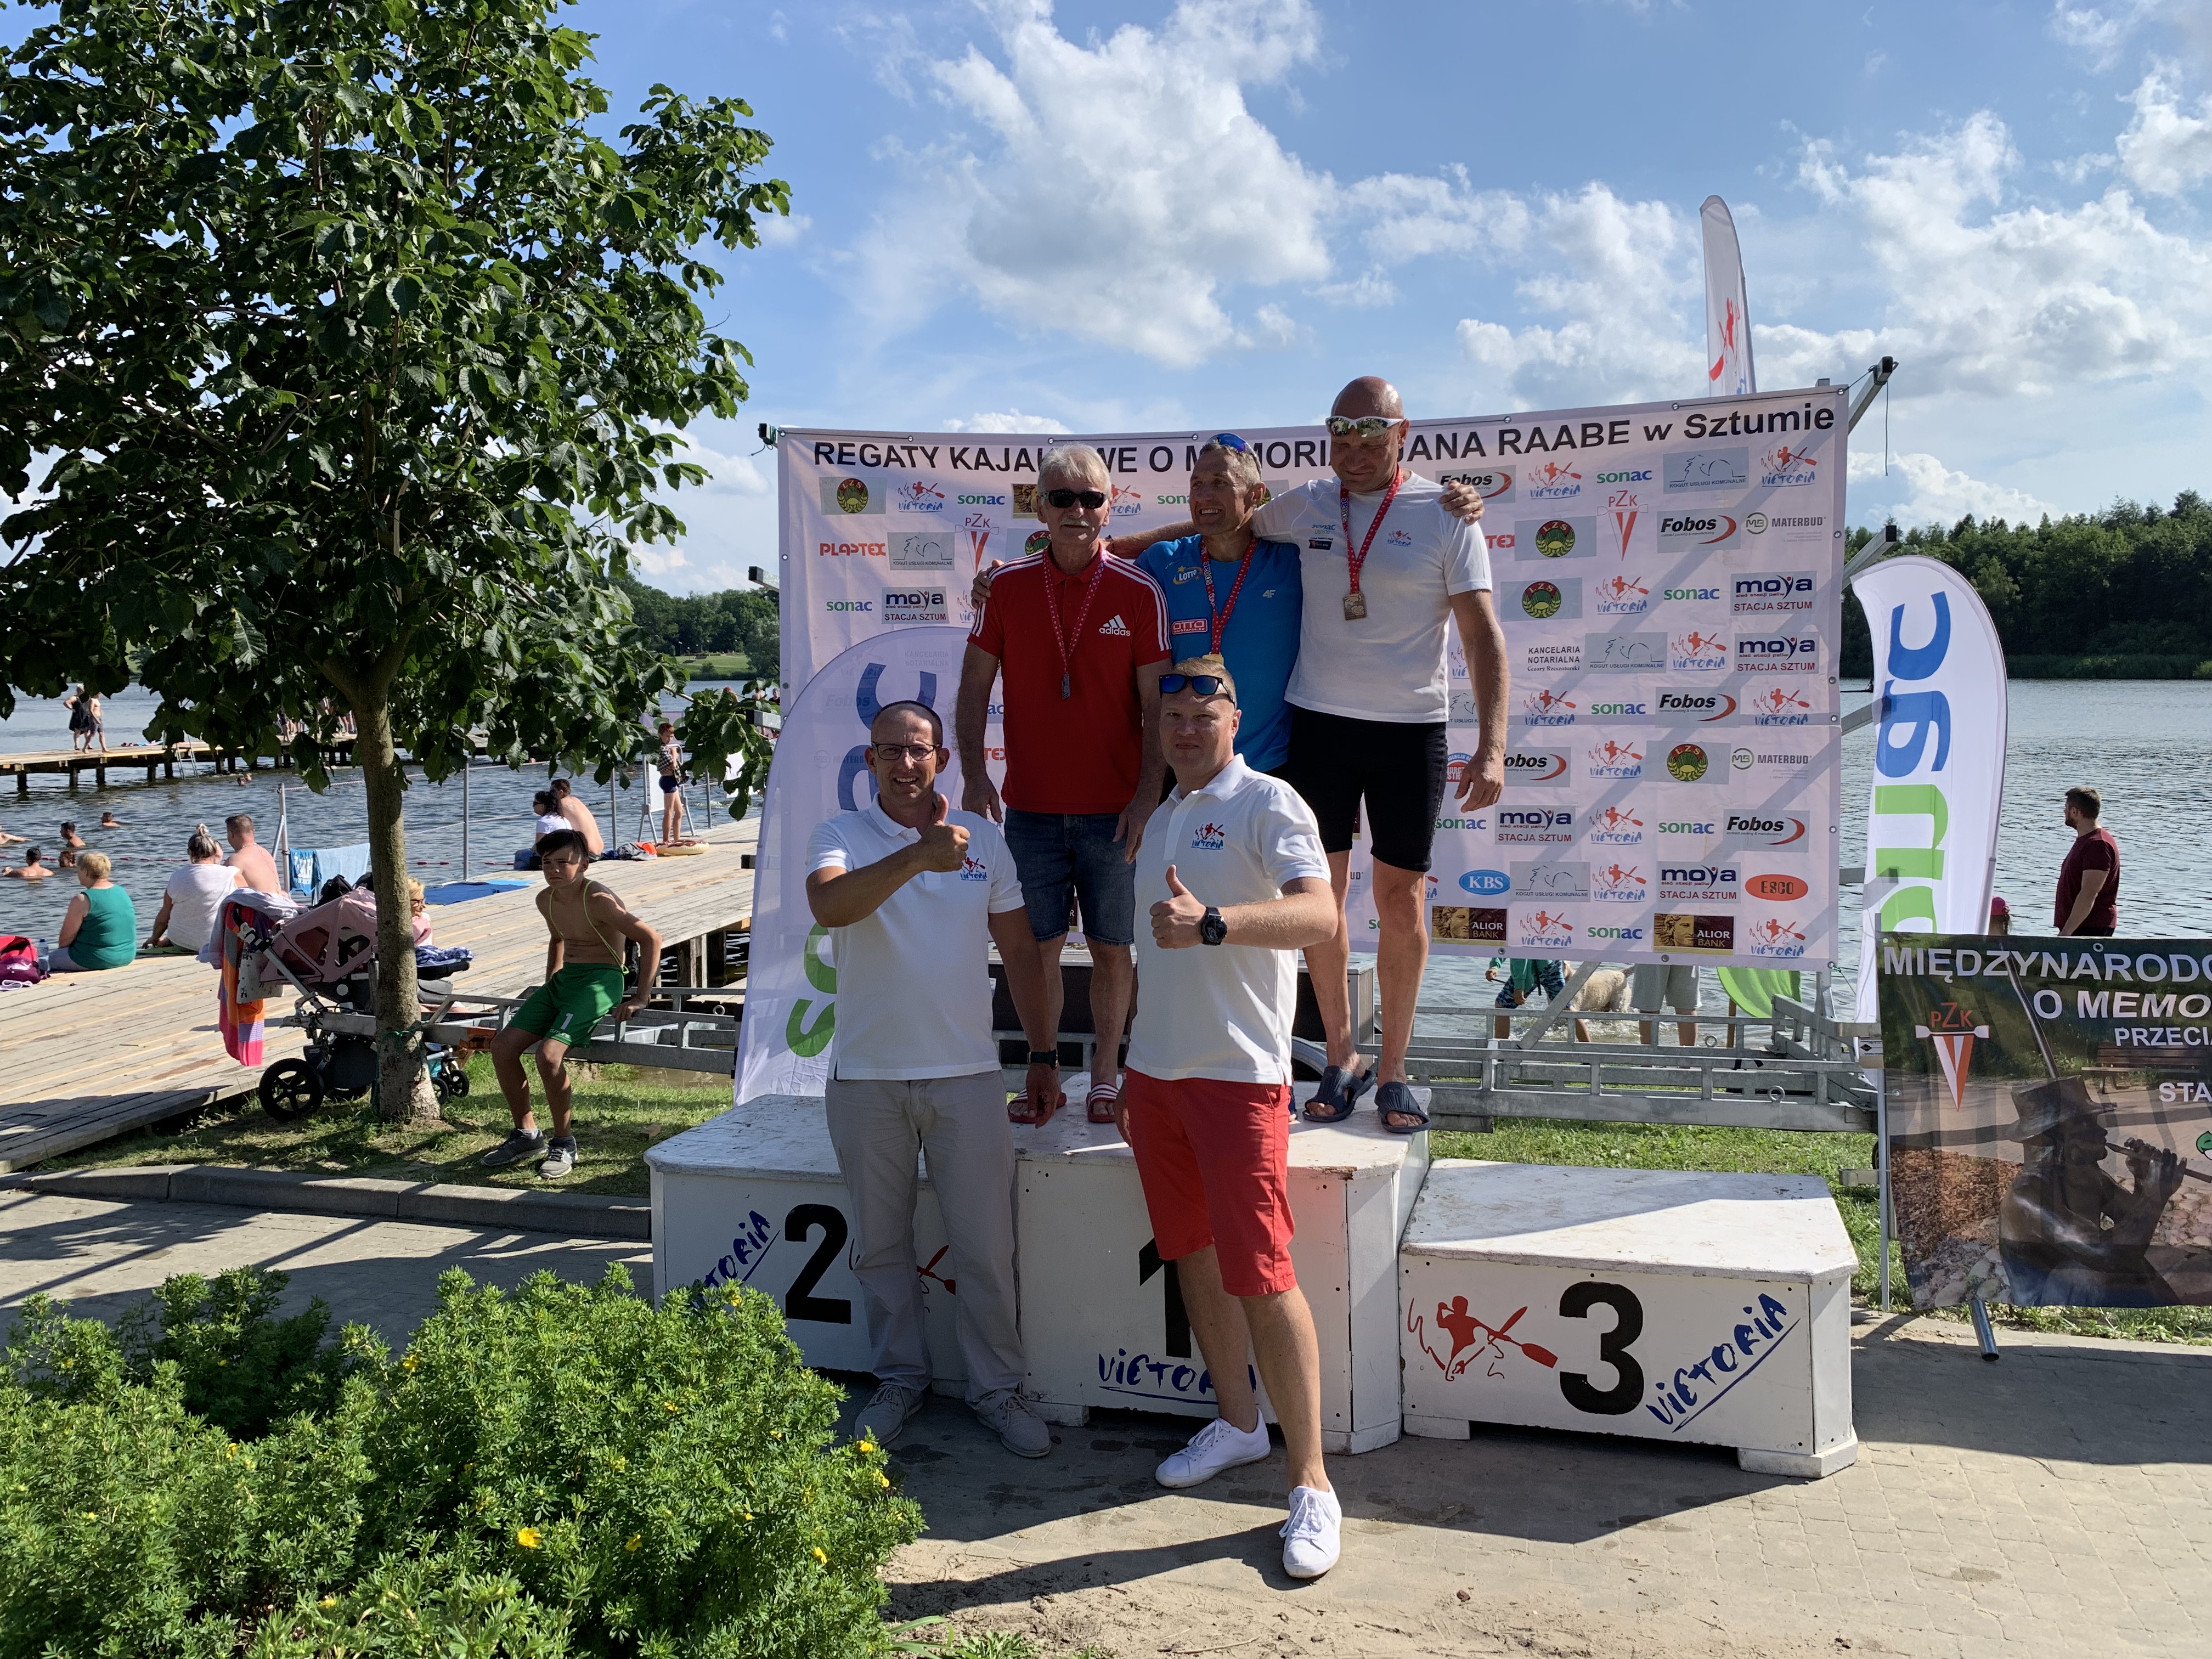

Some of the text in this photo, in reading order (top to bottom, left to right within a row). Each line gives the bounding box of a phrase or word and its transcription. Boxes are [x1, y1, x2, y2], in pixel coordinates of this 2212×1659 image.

[815, 442, 939, 467] REGATY
[1149, 446, 1173, 472] O
[1498, 420, 1630, 456] RAABE
[1643, 424, 1673, 441] w
[1684, 403, 1834, 439] Sztumie
[1597, 470, 1652, 483] sonac
[842, 479, 862, 492] LZS
[957, 495, 1006, 505] sonac
[1609, 490, 1638, 507] PZK
[965, 514, 990, 528] PZK
[1542, 521, 1567, 533] LZS
[1661, 517, 1717, 533] Fobos
[1771, 517, 1822, 527] MATERBUD
[1179, 569, 1197, 581] LOTTO
[1262, 589, 1276, 598] 4F
[1528, 583, 1554, 593] LZS
[1736, 575, 1812, 600] moya
[1664, 588, 1719, 600] sonac
[826, 601, 872, 611] sonac
[885, 590, 944, 611] moya
[1734, 601, 1812, 611] STACJA SZTUM
[1173, 620, 1205, 630] OTTO
[1099, 627, 1131, 636] adidas
[1528, 646, 1581, 654] KANCELARIA
[1739, 636, 1815, 661] moya
[1781, 662, 1815, 670] SZTUM
[1660, 694, 1716, 708] Fobos
[1591, 703, 1646, 715] sonac
[1675, 745, 1701, 755] LZS
[1503, 754, 1547, 768] obos
[1758, 755, 1808, 764] MATERBUD
[1500, 808, 1571, 832] moya
[1726, 816, 1784, 831] Fobos
[1658, 822, 1714, 834] sonac
[1498, 833, 1571, 842] STACJA SZTUM
[1470, 876, 1503, 889] KBS
[1661, 865, 1736, 889] moya
[1702, 891, 1736, 899] SZTUM
[1472, 922, 1503, 930] ALIOR
[1473, 930, 1499, 939] BANK
[1588, 927, 1643, 939] sonac
[1697, 929, 1730, 939] ALIOR
[1698, 939, 1725, 947] BANK
[2034, 990, 2062, 1019] O
[560, 1013, 574, 1030] 1
[1931, 1002, 1973, 1029] PZK
[785, 1204, 851, 1324] 2
[1559, 1281, 1644, 1415] 3
